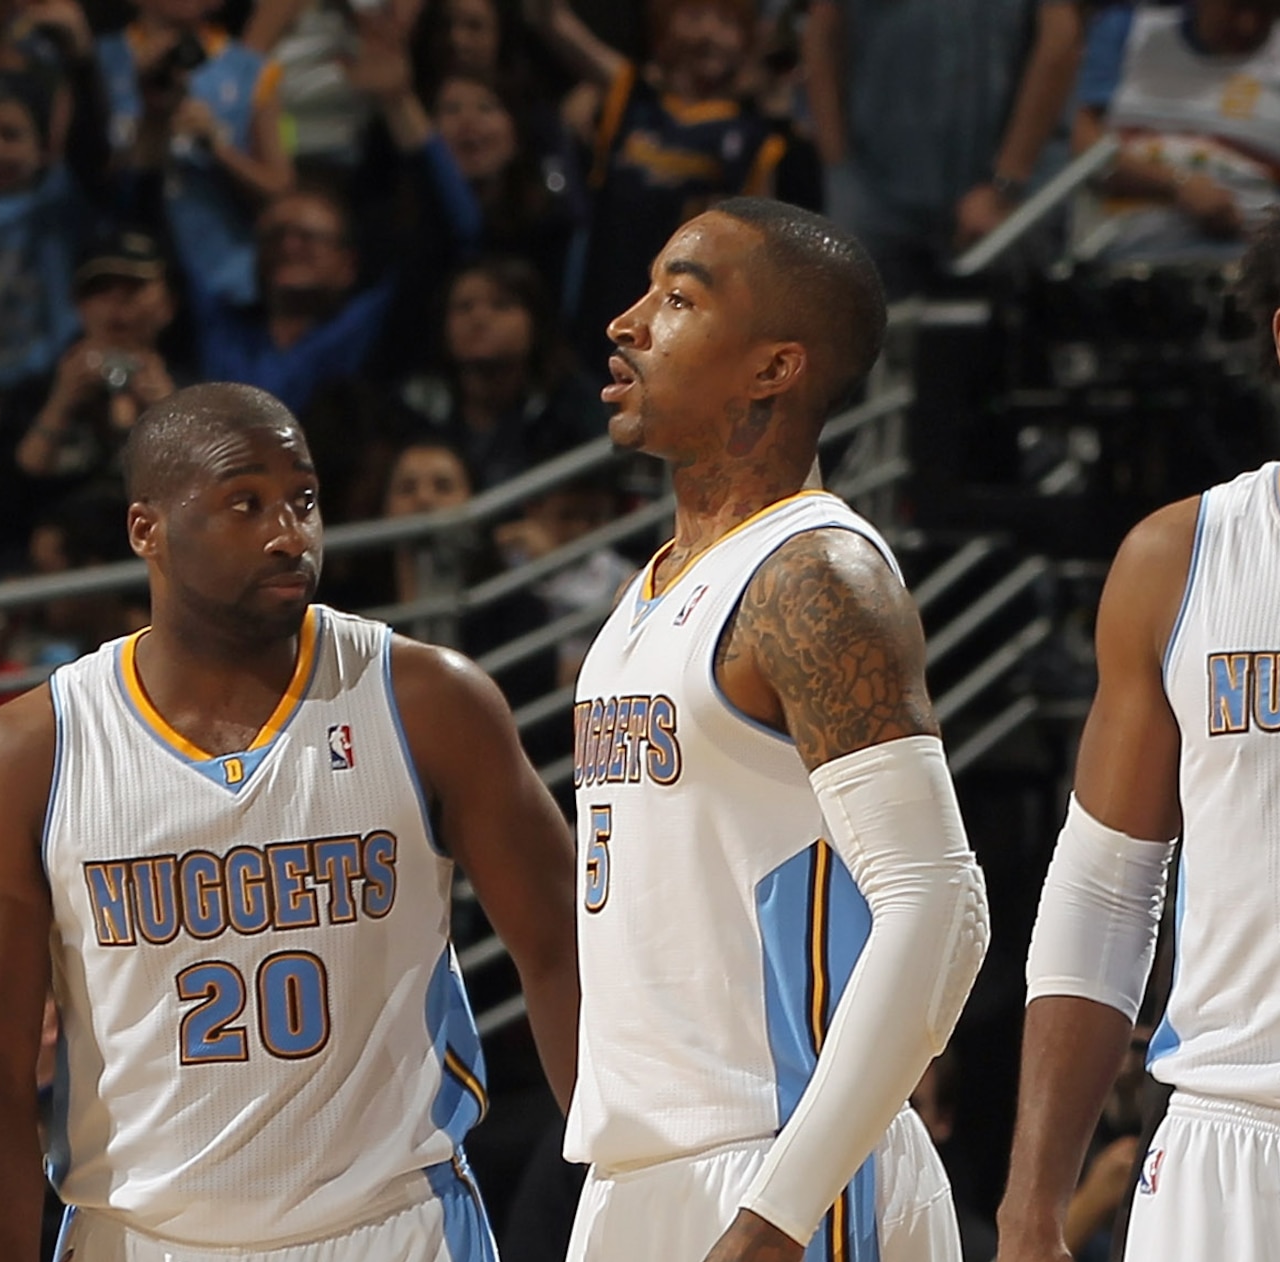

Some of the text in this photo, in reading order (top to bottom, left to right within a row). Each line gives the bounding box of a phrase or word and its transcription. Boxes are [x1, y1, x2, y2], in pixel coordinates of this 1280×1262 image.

[574, 694, 682, 787] UGGETS
[83, 830, 397, 946] NUGGETS
[175, 949, 330, 1066] 20
